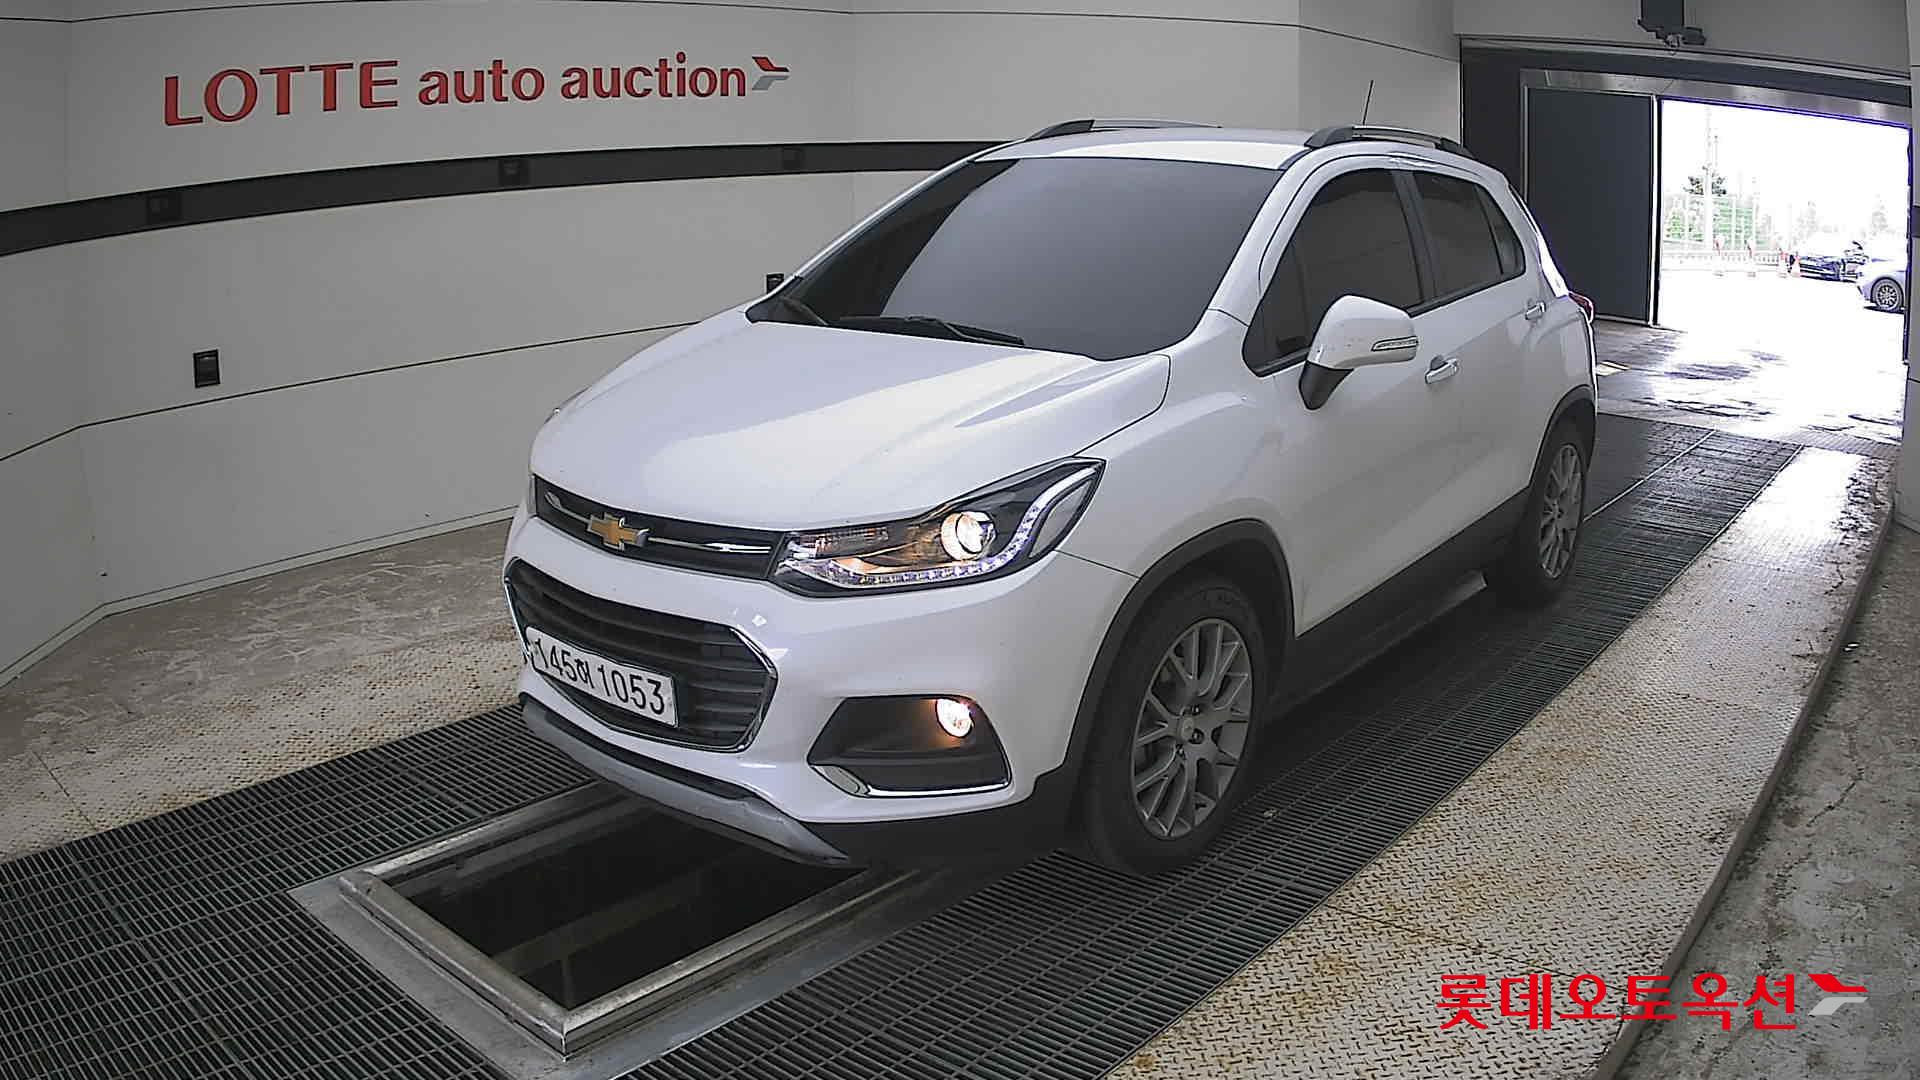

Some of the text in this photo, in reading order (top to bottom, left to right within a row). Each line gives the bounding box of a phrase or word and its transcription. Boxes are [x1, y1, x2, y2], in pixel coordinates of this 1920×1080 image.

[164, 51, 748, 126] LOTTE auto auction
[597, 664, 665, 715] 1053
